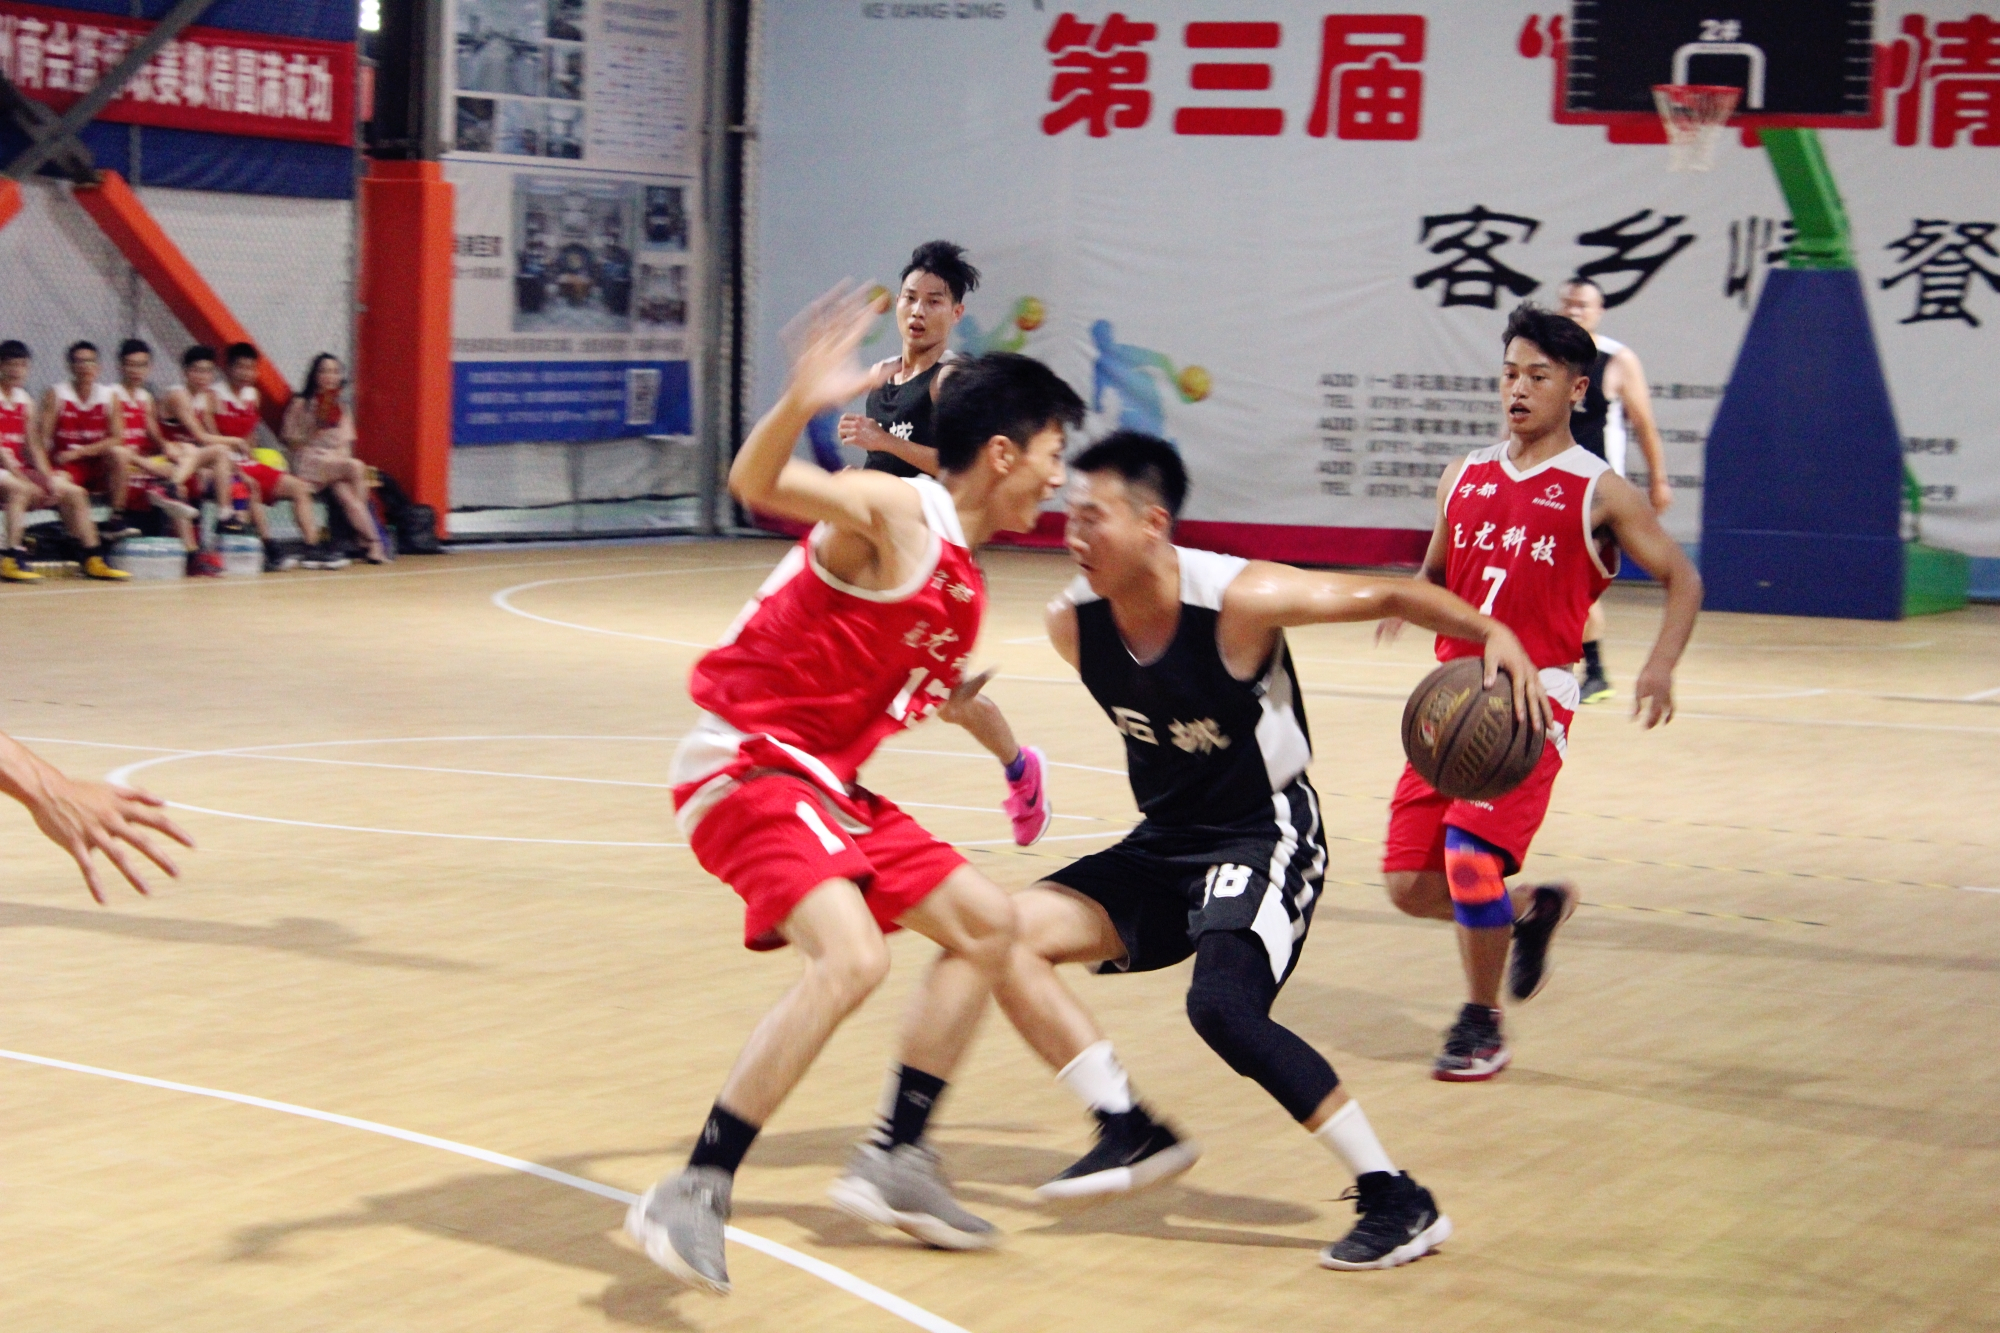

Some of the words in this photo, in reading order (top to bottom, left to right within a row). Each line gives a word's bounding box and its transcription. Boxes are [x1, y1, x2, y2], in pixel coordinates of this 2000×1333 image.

[1039, 12, 1428, 141] 第三届
[1458, 482, 1499, 499] 宁都
[1478, 565, 1508, 616] 7
